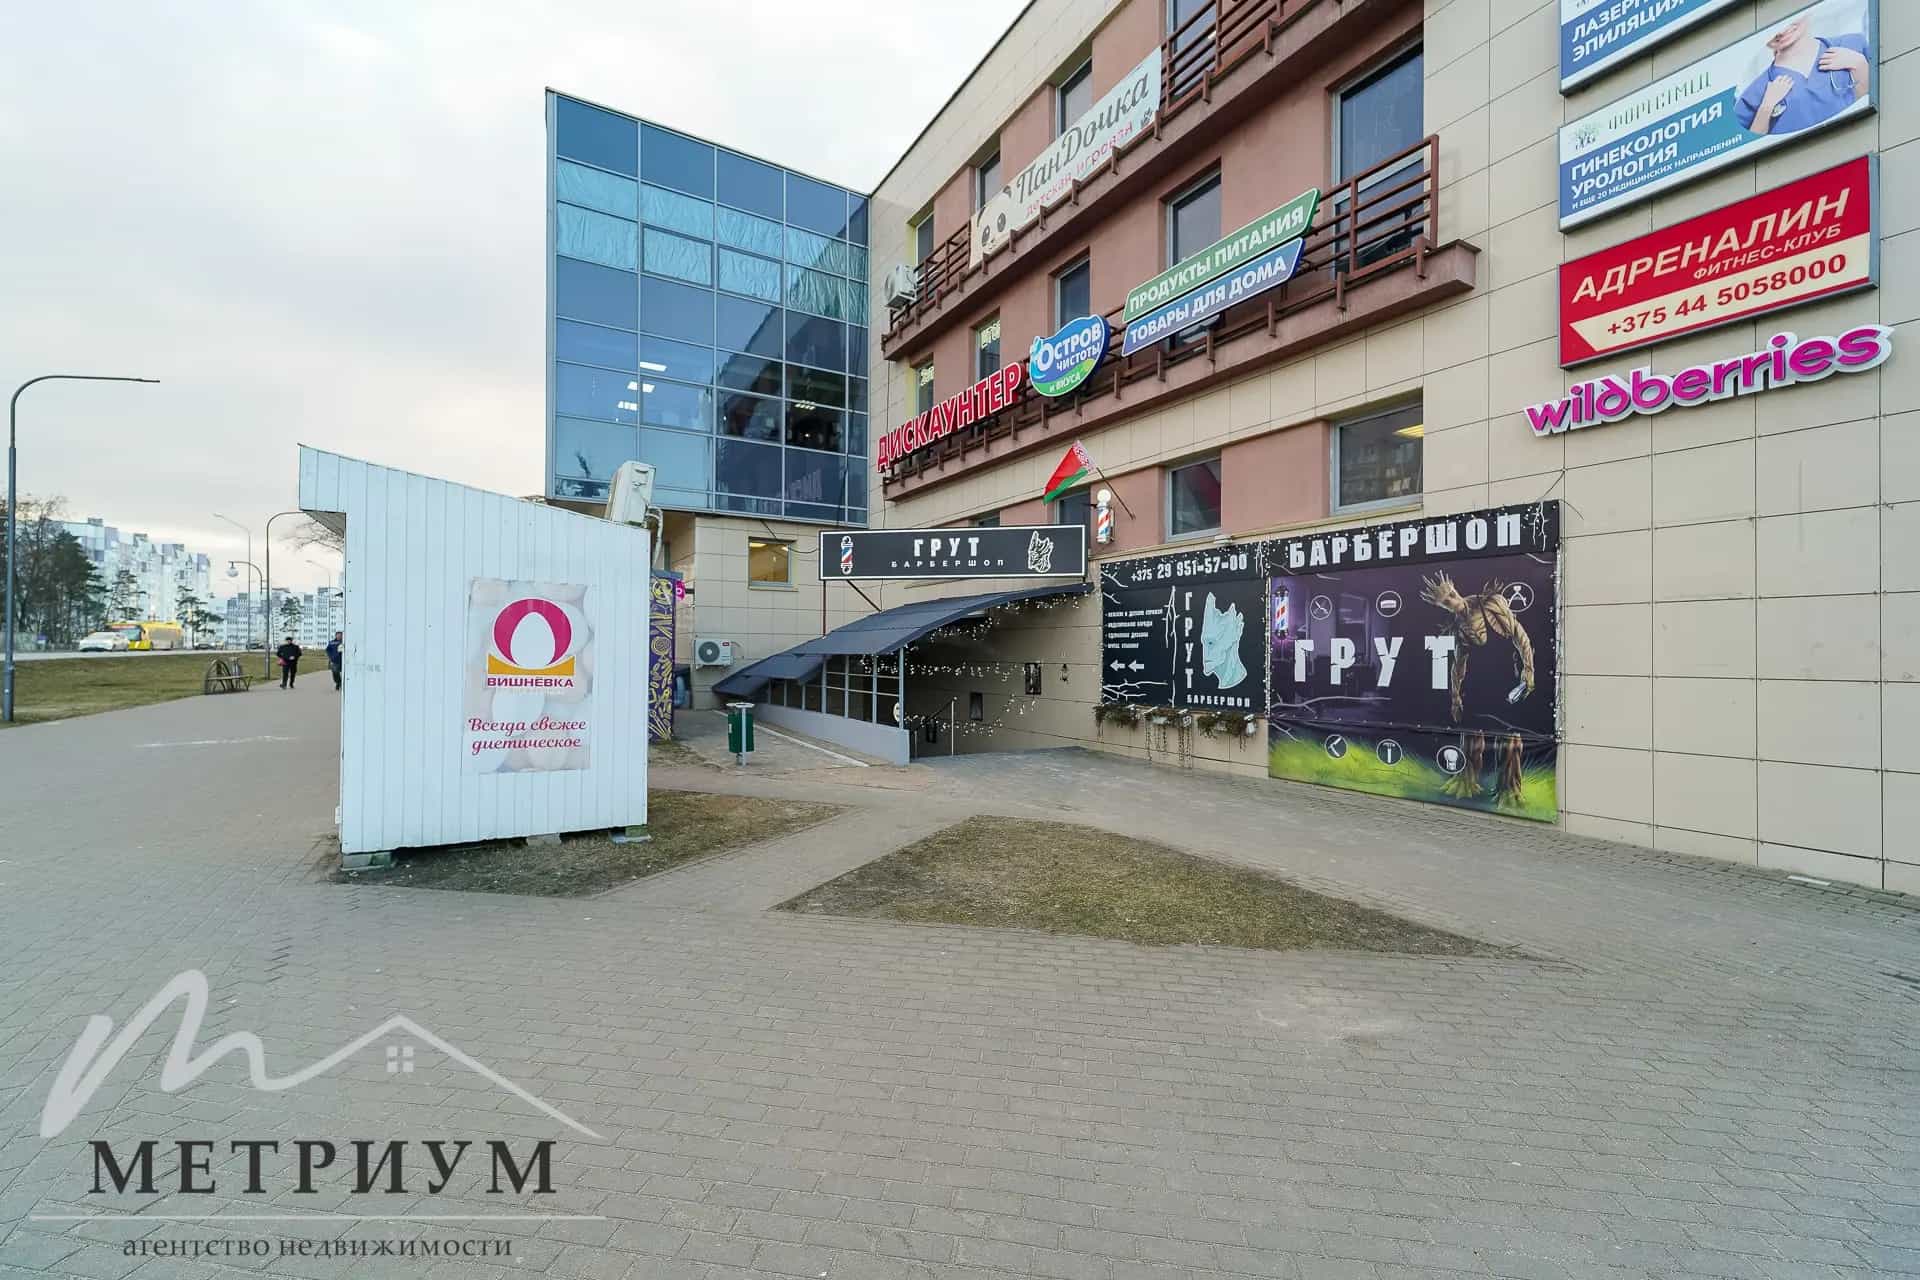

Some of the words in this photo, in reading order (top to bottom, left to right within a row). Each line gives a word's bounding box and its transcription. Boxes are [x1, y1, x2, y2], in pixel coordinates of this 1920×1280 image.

[1571, 101, 1723, 181] ГИНЕКОЛОГИЯ
[1674, 133, 1743, 169] НАПРАВЛЕНИЙ
[1571, 142, 1678, 200] УРОЛОГИЯ
[1129, 260, 1211, 314] ПРОДУКТЫ
[1214, 205, 1304, 268] ПИТАНИЯ
[1572, 187, 1851, 304] АДРЕНАЛИН
[1693, 223, 1842, 281] ФИТНЕС-КЛУБ
[1130, 304, 1189, 345] ТОВАРЫ
[1191, 288, 1226, 318] ДЛЯ
[1229, 255, 1287, 297] ДОМА
[1607, 307, 1667, 335] +375
[1674, 295, 1708, 318] 44
[1717, 253, 1847, 307] 5058000
[1036, 322, 1101, 372] ОСТРОВ
[1056, 342, 1100, 372] ЧИСТОТЫ
[1525, 327, 1882, 432] wildberries
[876, 361, 1021, 473] ДИСКАУНТЕР
[891, 559, 1005, 568] БАРБЕРШОП
[913, 537, 980, 557] ГРУТ
[1289, 512, 1522, 569] БАРБЕРШОП
[1131, 568, 1153, 582] +375
[1157, 563, 1172, 579] 29
[1185, 591, 1194, 689] ГРУТ
[1293, 635, 1456, 690] ГРУТ
[468, 717, 526, 737] Всегда
[530, 716, 587, 731] свежее
[1186, 694, 1251, 708] БАРБЕРШОП
[471, 737, 583, 756] диетическое
